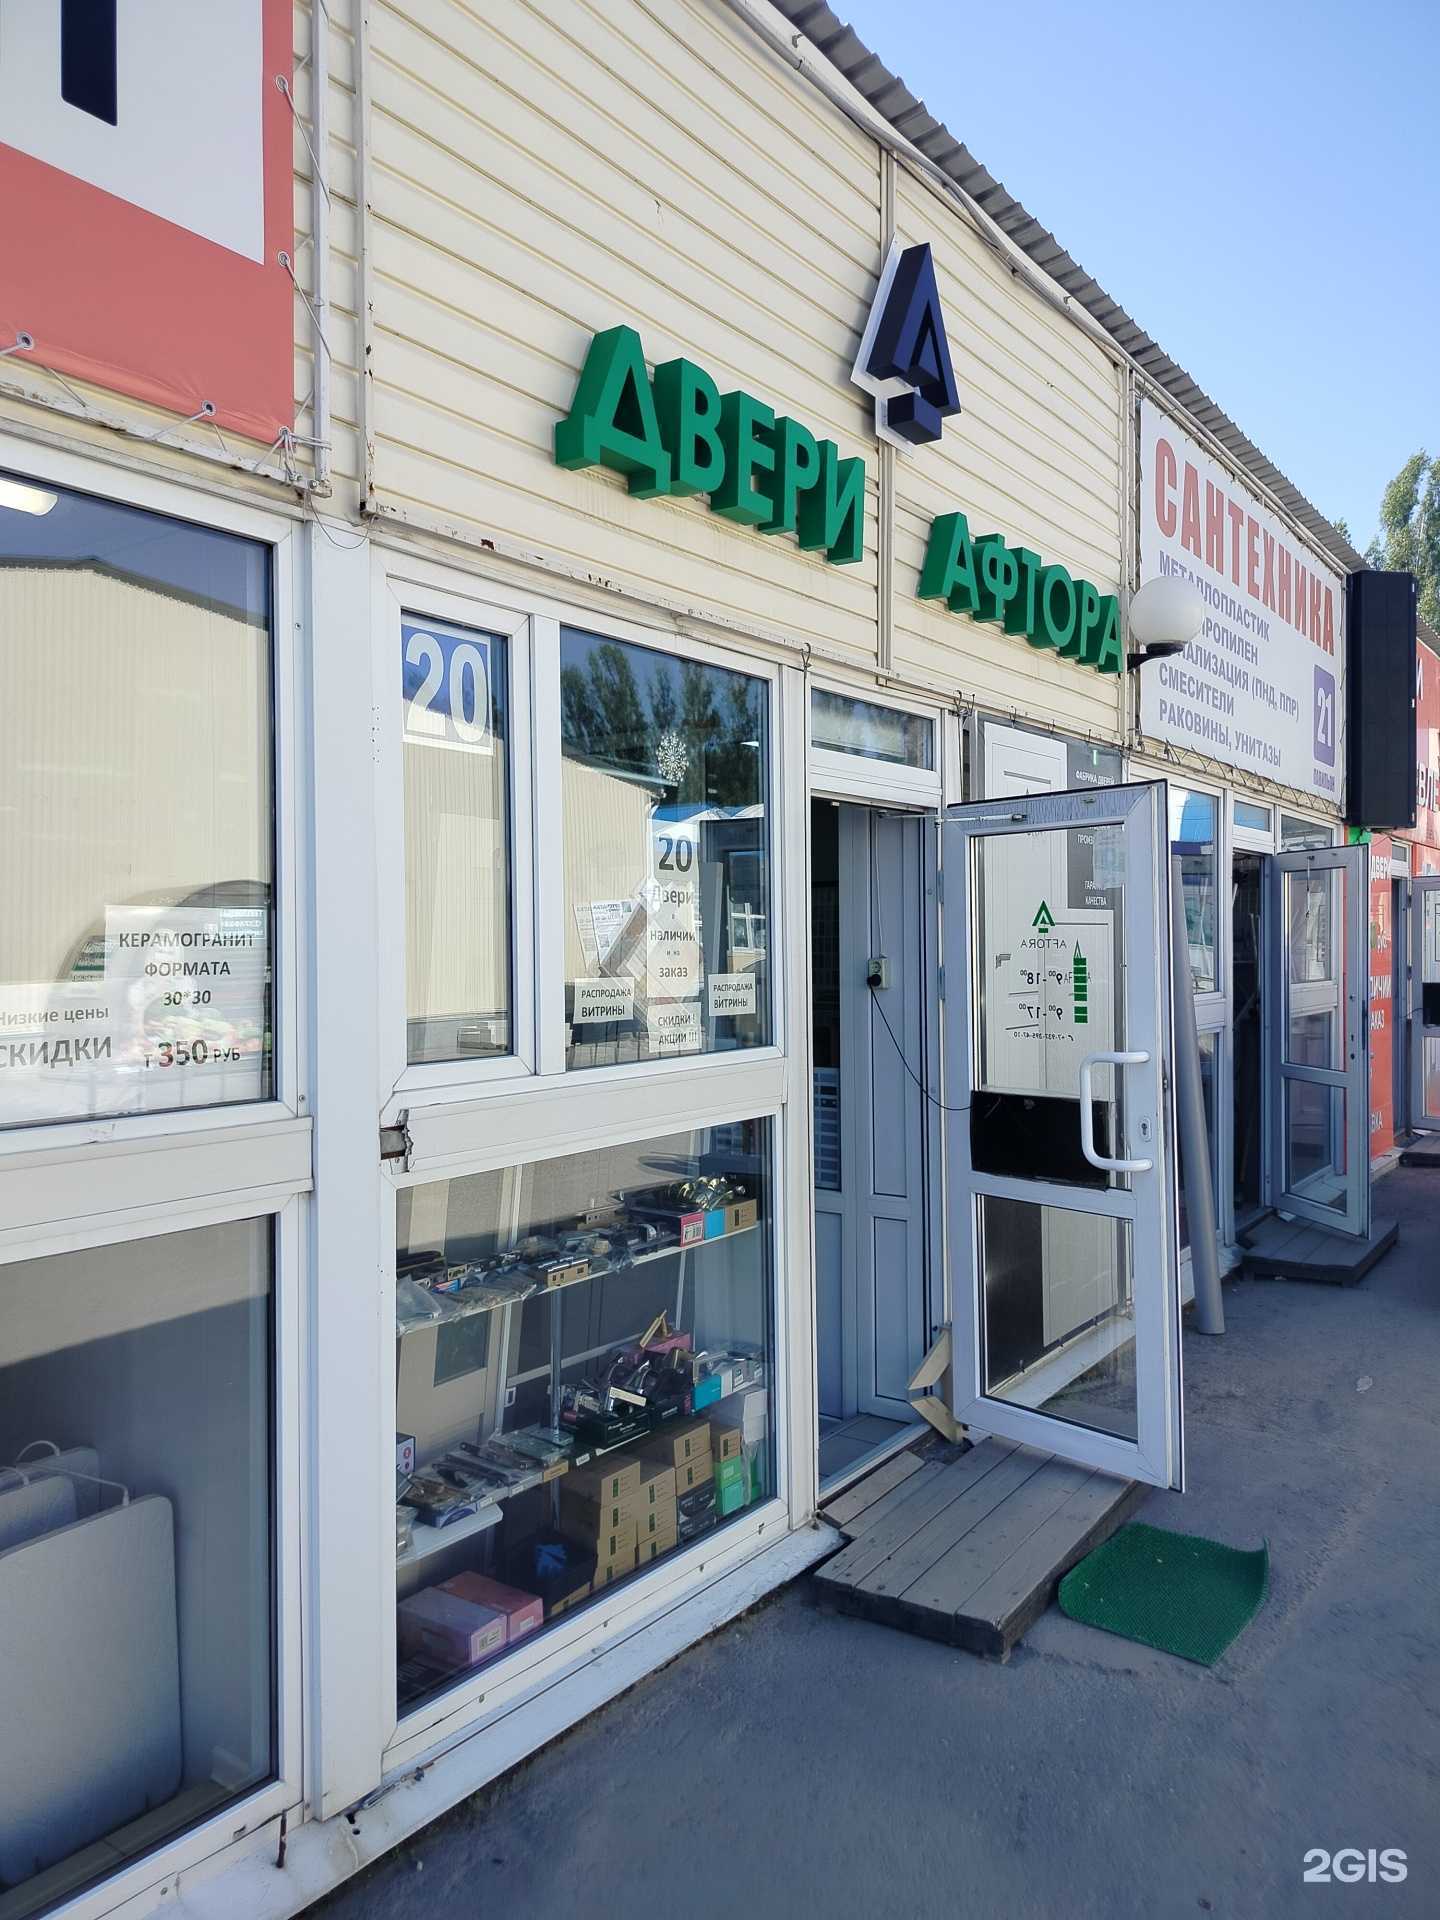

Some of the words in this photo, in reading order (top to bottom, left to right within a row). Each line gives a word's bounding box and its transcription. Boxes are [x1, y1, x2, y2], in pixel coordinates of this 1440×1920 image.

[555, 324, 865, 566] ДВЕРИ
[1155, 437, 1335, 657] САНТЕХНИКА
[917, 511, 1123, 674] АФТОРА
[405, 632, 488, 742] 20
[1159, 661, 1234, 717] СМЕСИТЕЛИ
[1252, 676, 1278, 711] (ПНД,
[1279, 692, 1299, 723] ППР)
[1318, 687, 1333, 748] 21
[1159, 697, 1232, 752] РАКОВИНЫ,
[1235, 730, 1281, 768] УНИТАЗЫ
[658, 835, 693, 873] 20
[119, 932, 253, 948] КЕРАМОГРАНИТ
[650, 930, 696, 942] наличии
[145, 961, 231, 977] ФОРМАТА
[659, 967, 688, 978] заказ
[581, 988, 632, 999] РАСПРОДАЖА
[713, 983, 753, 992] РАСПРОДАЖА
[581, 1005, 625, 1017] ВИТРИНЫ
[714, 998, 747, 1009] ВИТРИНЫ
[64, 1008, 109, 1024] цены
[658, 1015, 691, 1028] СКИДКИ
[659, 1033, 687, 1046] АКЦИИ
[159, 1039, 208, 1068] 350
